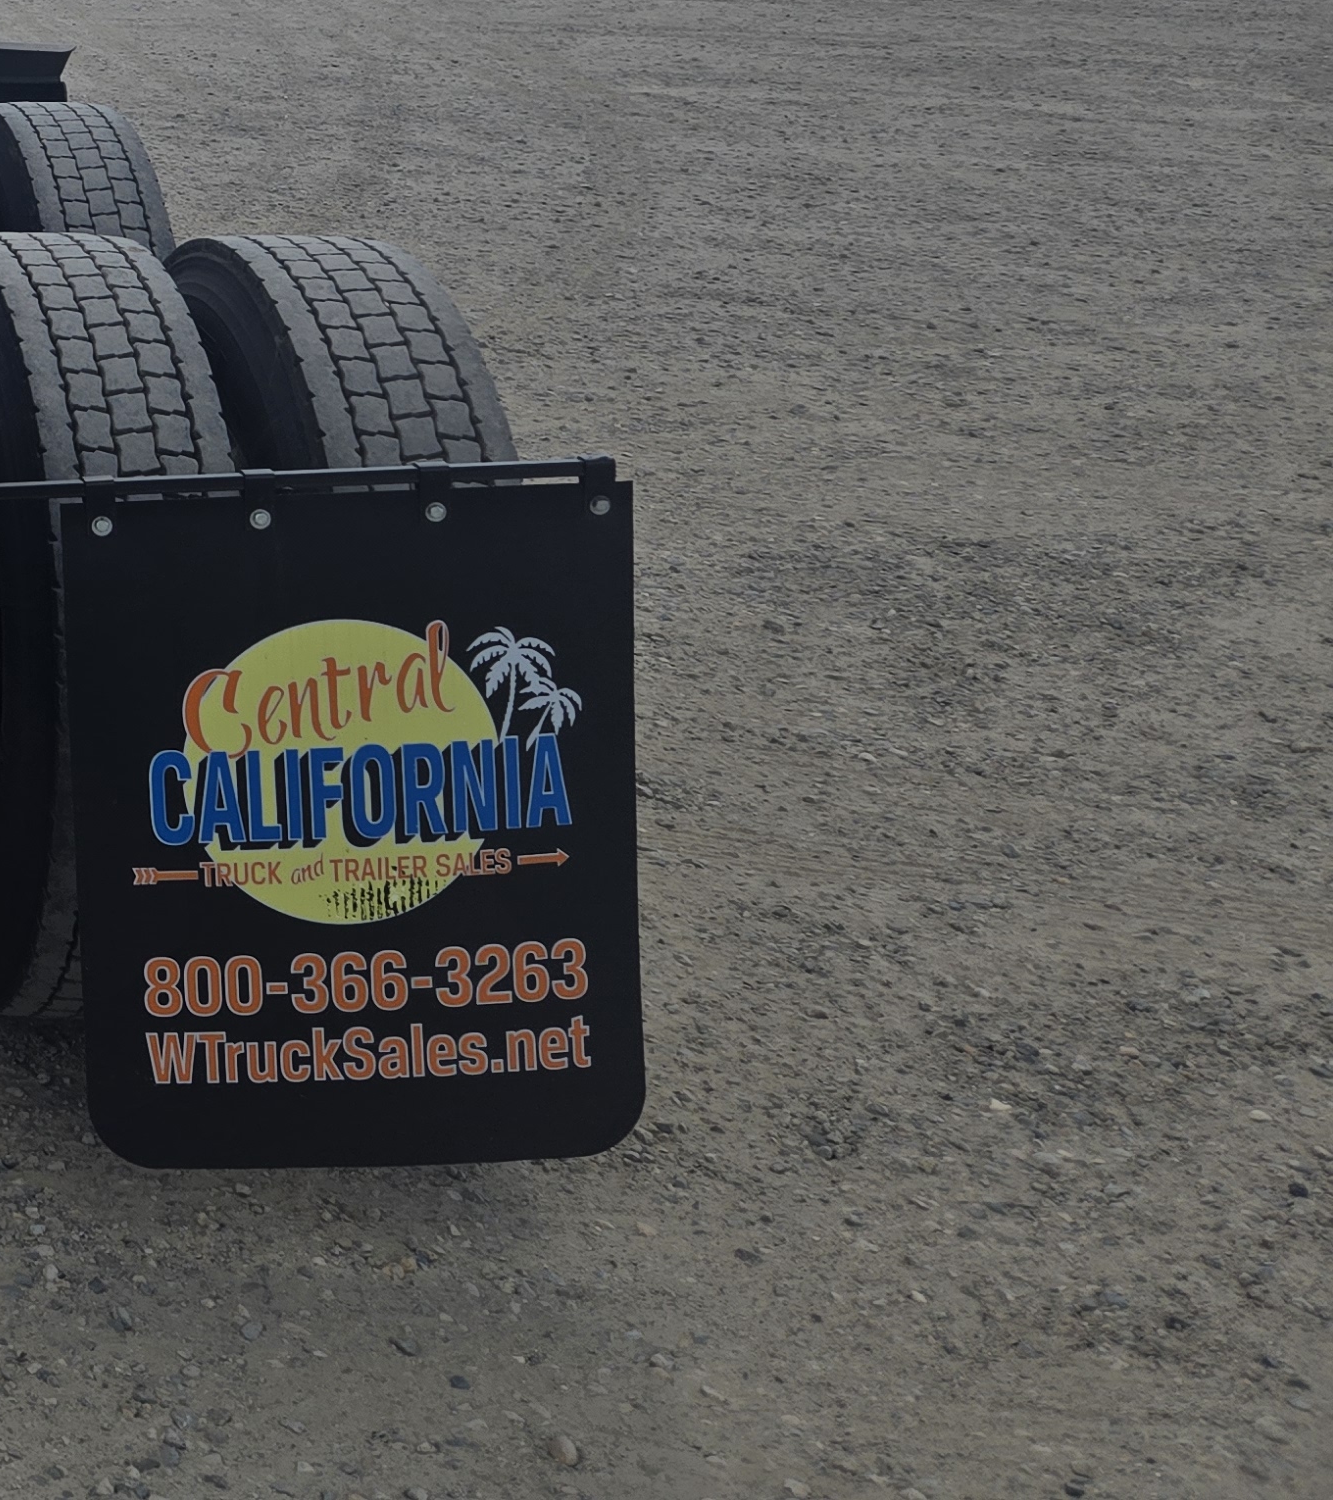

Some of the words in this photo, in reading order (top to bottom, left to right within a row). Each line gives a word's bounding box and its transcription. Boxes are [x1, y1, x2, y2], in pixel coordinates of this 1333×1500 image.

[183, 619, 456, 759] Central
[148, 732, 573, 848] CALIFORNIA
[199, 861, 282, 888] TRUCK
[290, 853, 324, 886] and
[329, 855, 429, 884] TRAILER
[435, 848, 513, 879] SALES
[143, 937, 589, 1018] 800-366-3263
[145, 1015, 593, 1085] WTruckSales.net
